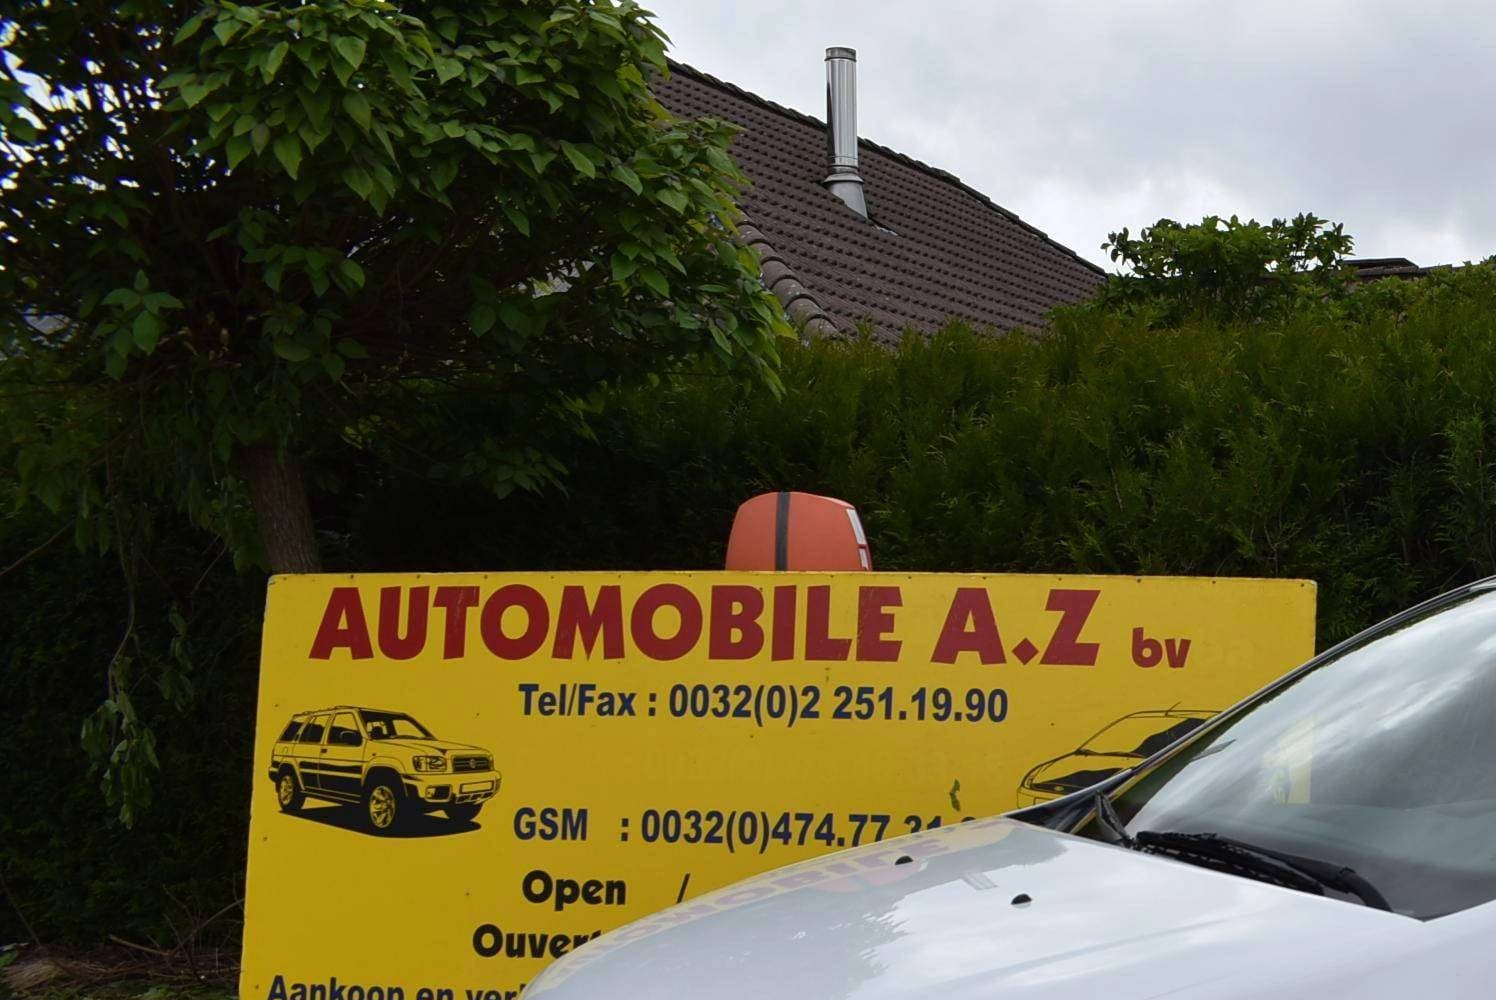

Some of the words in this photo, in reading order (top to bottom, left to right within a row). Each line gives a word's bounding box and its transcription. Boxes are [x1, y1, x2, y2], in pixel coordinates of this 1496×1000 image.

[309, 584, 902, 661] AUTOMOBILE
[931, 588, 1100, 665] A.Z
[1132, 628, 1190, 668] bv
[518, 683, 636, 717] Tel/Fax
[669, 684, 820, 727] 0032(0)2
[833, 686, 1008, 723] 251.19.90
[513, 807, 588, 841] GSM
[522, 870, 626, 911] Open
[472, 924, 600, 959] Ouver
